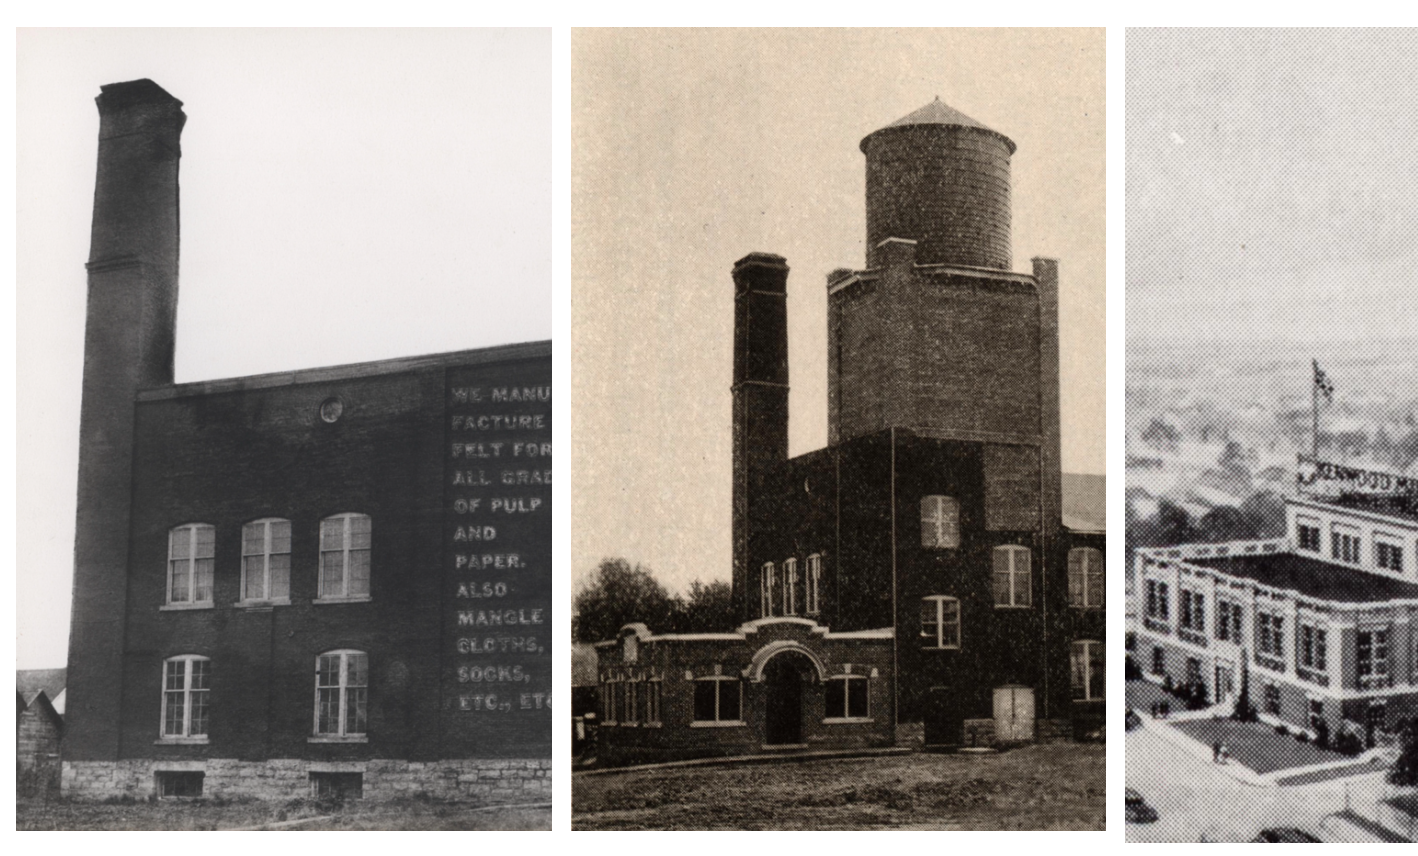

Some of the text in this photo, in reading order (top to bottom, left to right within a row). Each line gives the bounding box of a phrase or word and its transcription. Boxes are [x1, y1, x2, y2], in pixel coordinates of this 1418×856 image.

[451, 385, 551, 403] WE MANU
[451, 414, 546, 430] FACTURE
[451, 441, 551, 459] FELT FOR
[452, 469, 492, 486] ALL
[453, 497, 543, 514] OF PULP
[453, 525, 498, 542] AND
[455, 553, 527, 570] PAPER.
[457, 608, 545, 626] MANGLE
[457, 636, 545, 656] CLOTHS,
[457, 664, 531, 684] SOCKS,
[459, 693, 512, 713] ETC.,
